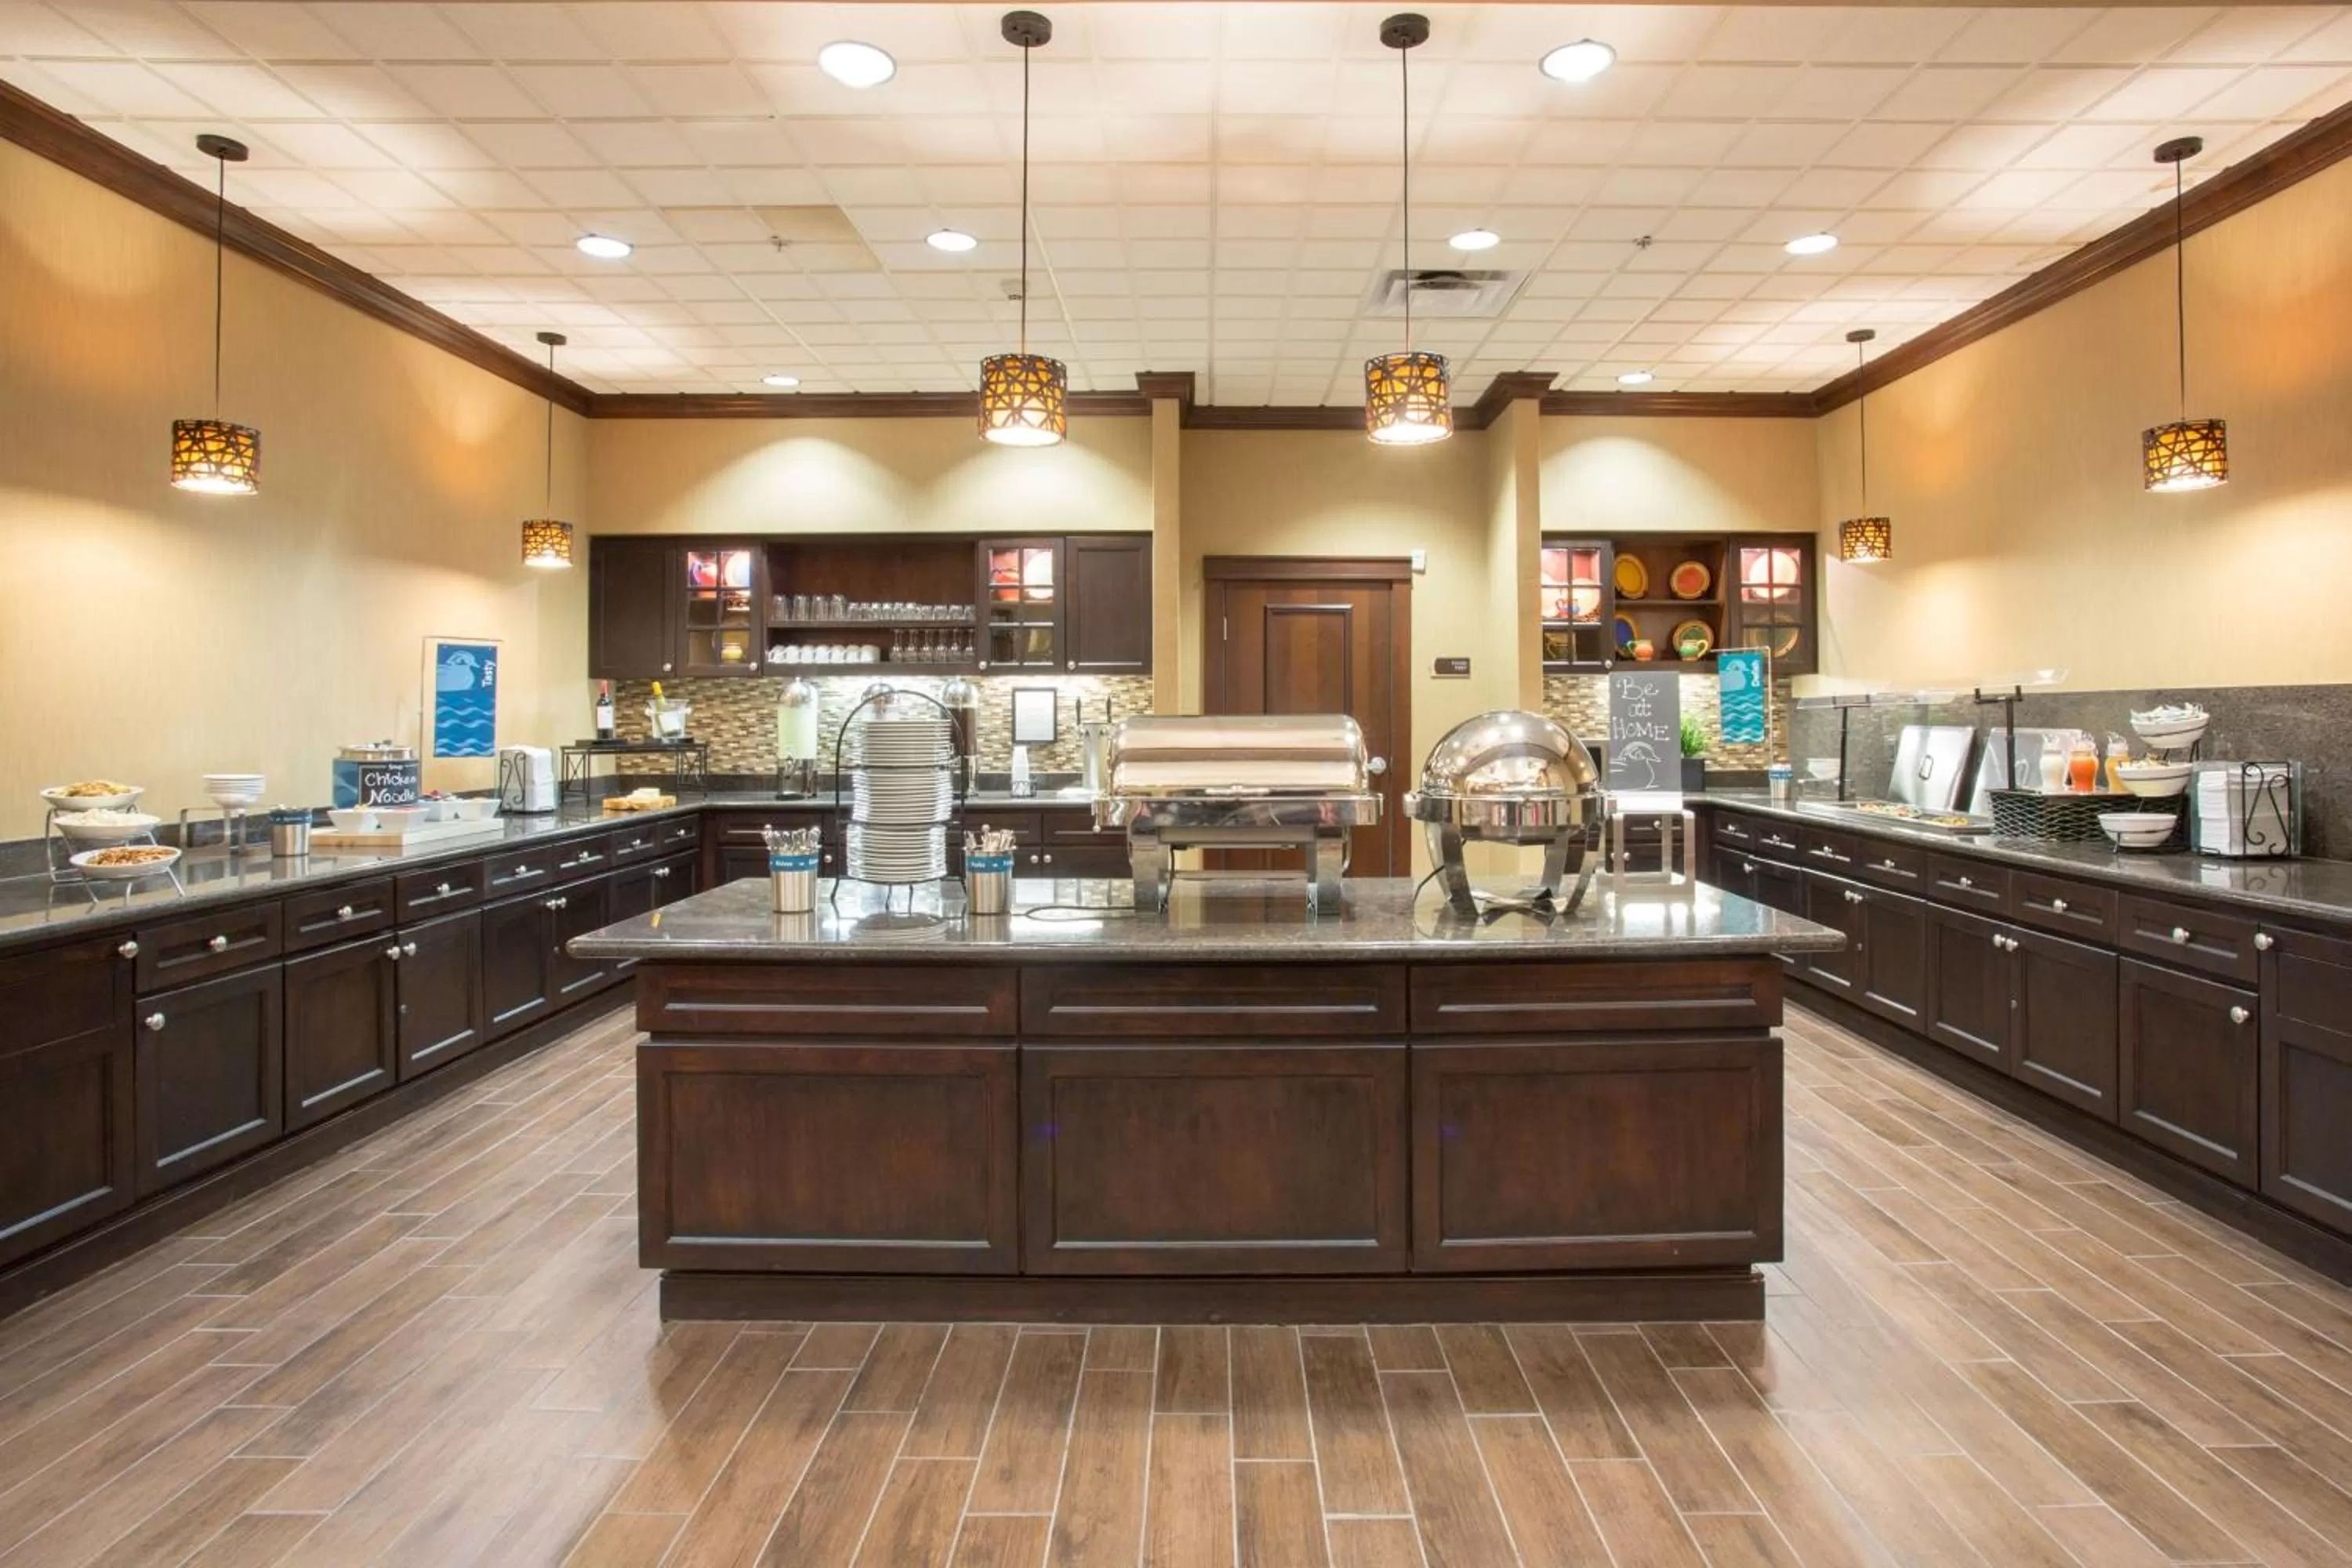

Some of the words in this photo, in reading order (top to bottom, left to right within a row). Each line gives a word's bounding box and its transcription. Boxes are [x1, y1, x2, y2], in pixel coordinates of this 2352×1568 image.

[481, 659, 495, 688] Tasty
[1615, 675, 1659, 700] Be
[1628, 698, 1652, 717] at
[1612, 716, 1670, 741] HOME
[365, 771, 417, 786] Chicken
[367, 787, 416, 805] Noodle
